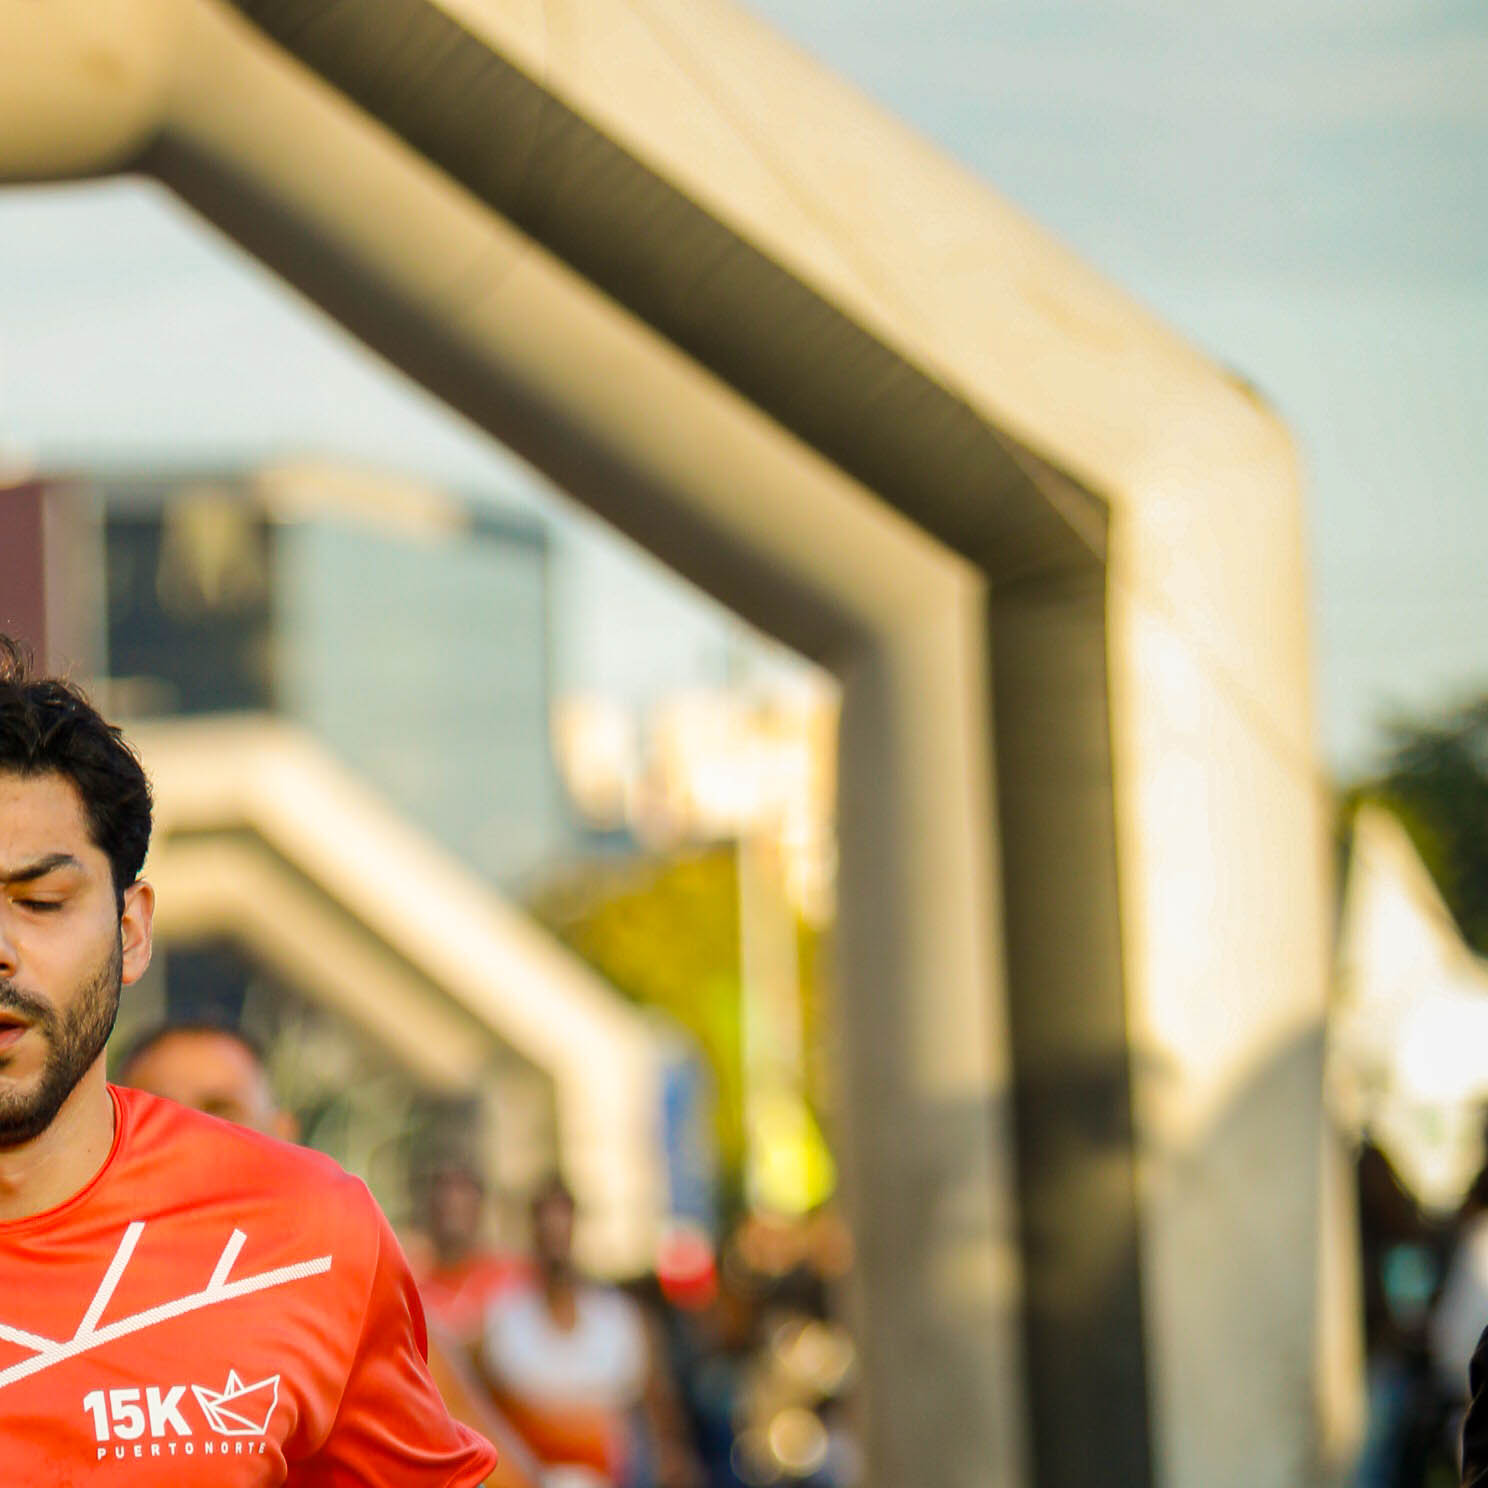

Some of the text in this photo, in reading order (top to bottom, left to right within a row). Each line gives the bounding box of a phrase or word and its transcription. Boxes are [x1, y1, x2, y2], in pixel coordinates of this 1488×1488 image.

[83, 1385, 193, 1442] 15K
[97, 1441, 267, 1460] PUERTO NORTE
